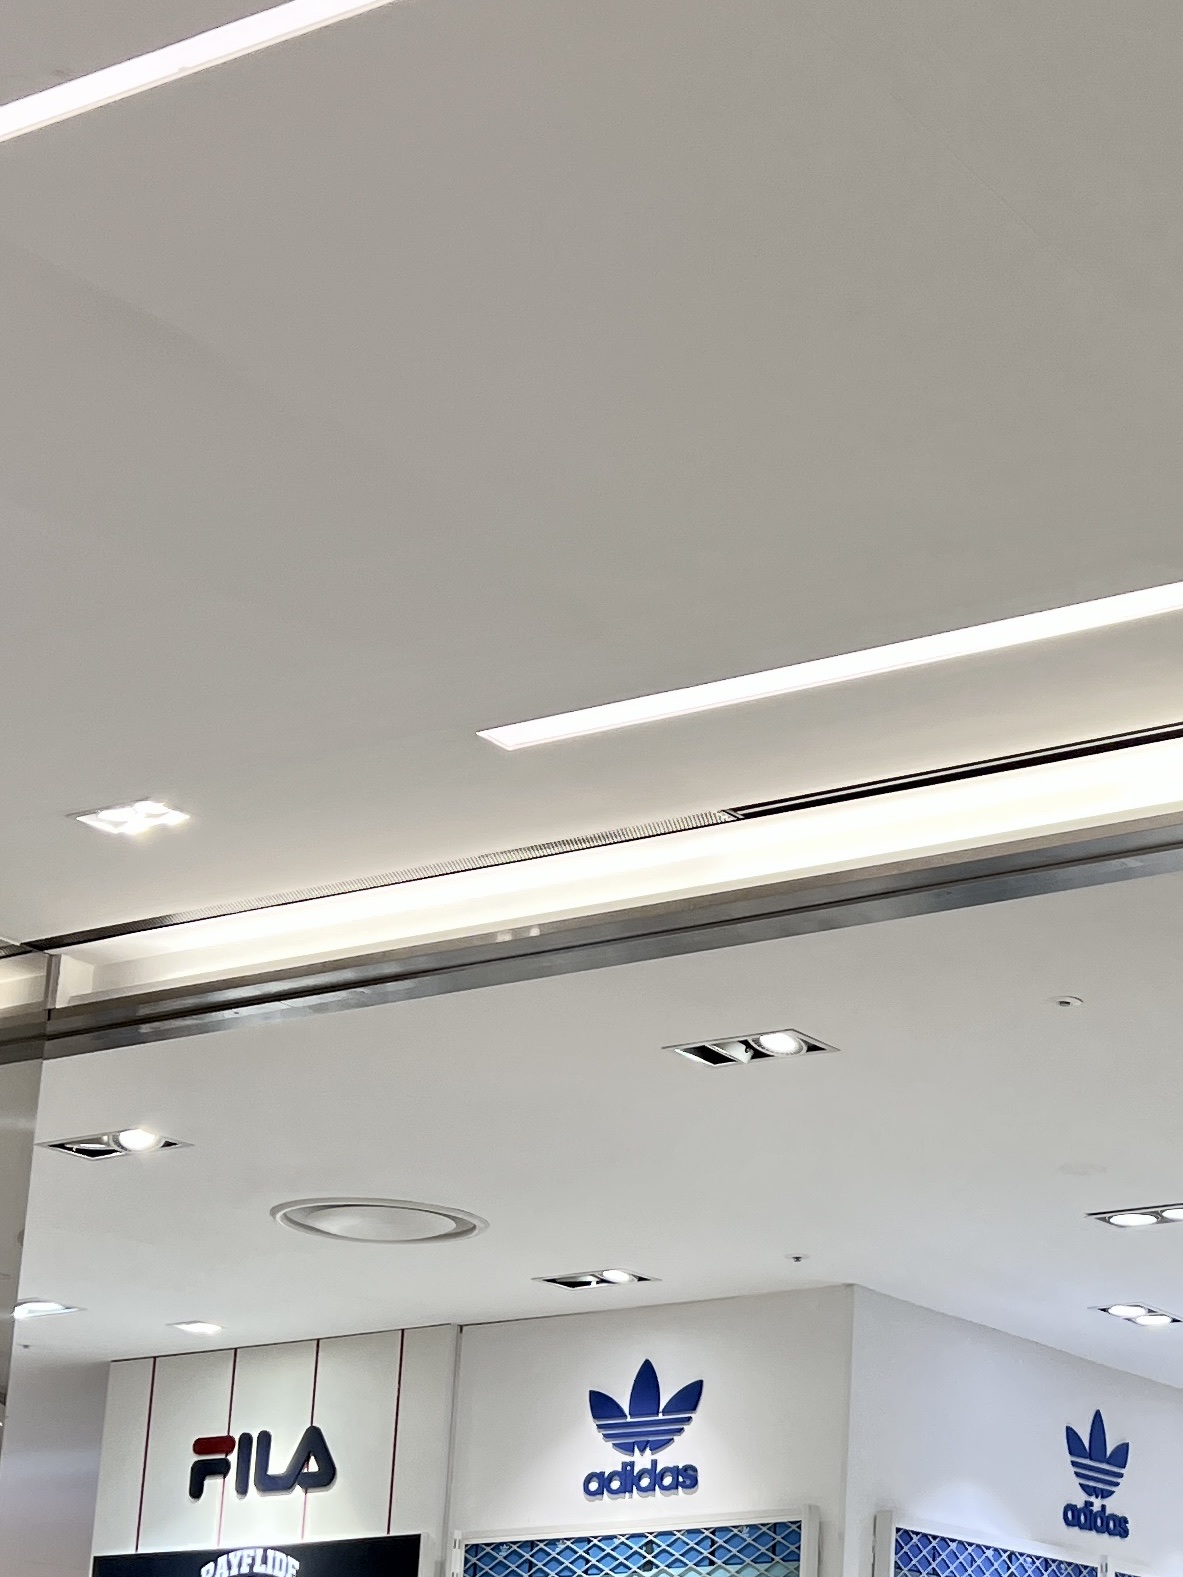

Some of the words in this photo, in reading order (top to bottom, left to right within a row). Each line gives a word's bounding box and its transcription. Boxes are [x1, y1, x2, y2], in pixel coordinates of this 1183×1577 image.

[189, 1425, 337, 1499] FILA
[583, 1459, 699, 1497] adidas
[1063, 1500, 1130, 1539] adidas
